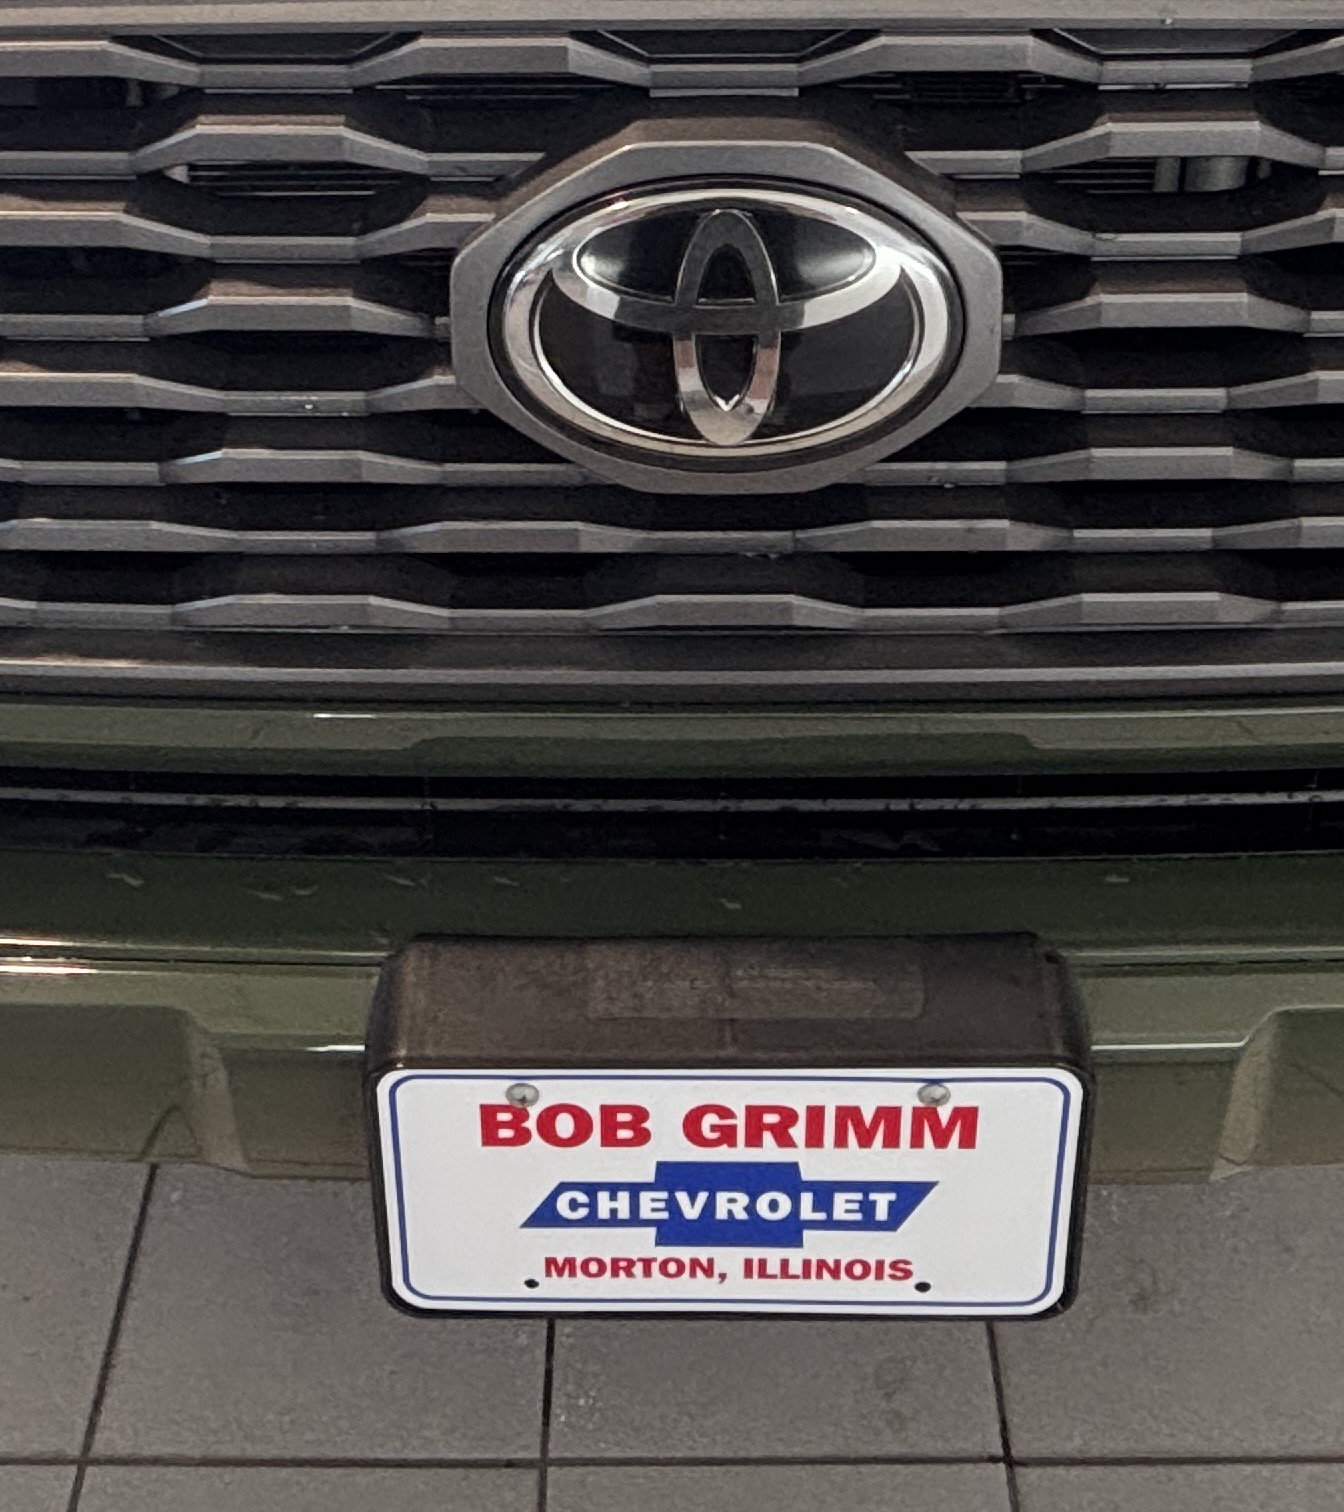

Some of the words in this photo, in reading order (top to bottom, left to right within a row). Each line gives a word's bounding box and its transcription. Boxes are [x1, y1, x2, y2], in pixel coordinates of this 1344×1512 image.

[479, 1104, 651, 1148] BOB
[682, 1104, 979, 1150] GRIMM
[556, 1190, 897, 1222] CHEVROLET
[544, 1257, 728, 1284] MORTON,
[742, 1258, 914, 1281] ILLINOIS
